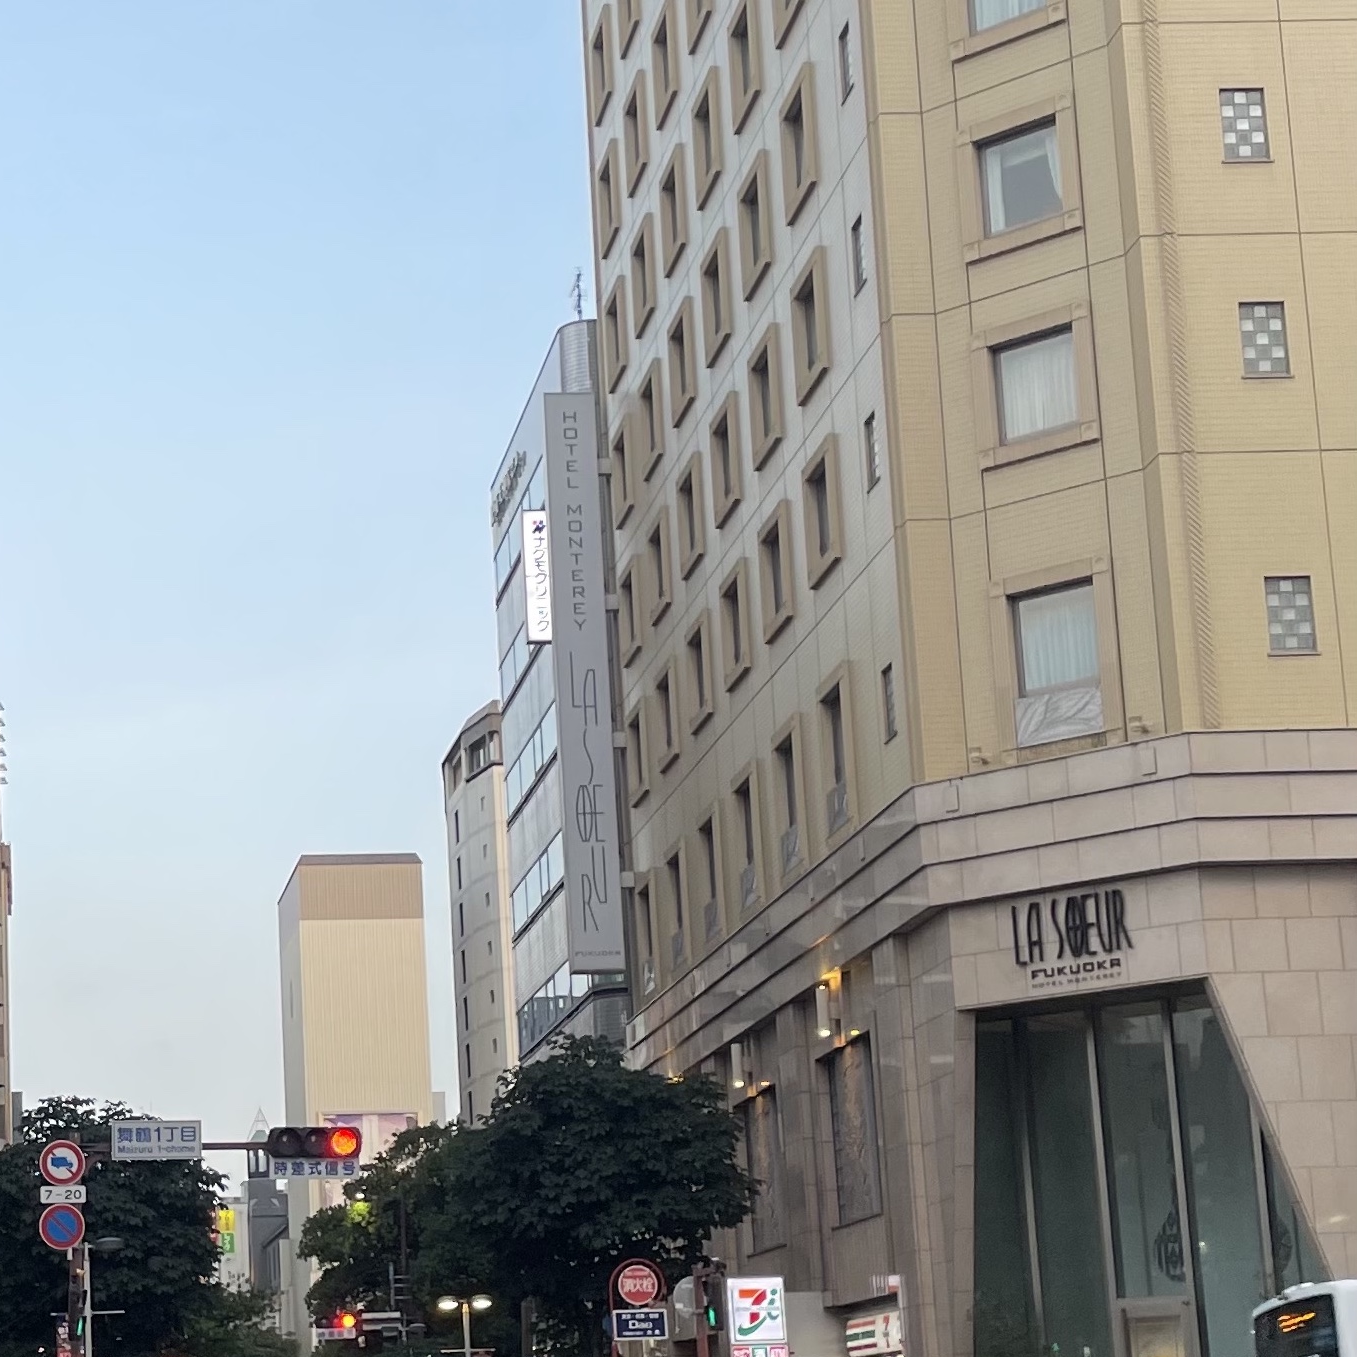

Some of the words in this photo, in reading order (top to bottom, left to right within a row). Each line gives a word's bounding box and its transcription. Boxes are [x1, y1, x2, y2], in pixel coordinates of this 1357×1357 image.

[562, 411, 580, 489] HOTEL
[566, 504, 587, 632] MONTEREY
[569, 651, 598, 727] LA
[1011, 901, 1045, 966] LA
[1030, 957, 1122, 980] FUKUOKA
[117, 1126, 197, 1144] 舞鶴1丁目
[274, 1161, 356, 1176] 時差式信号
